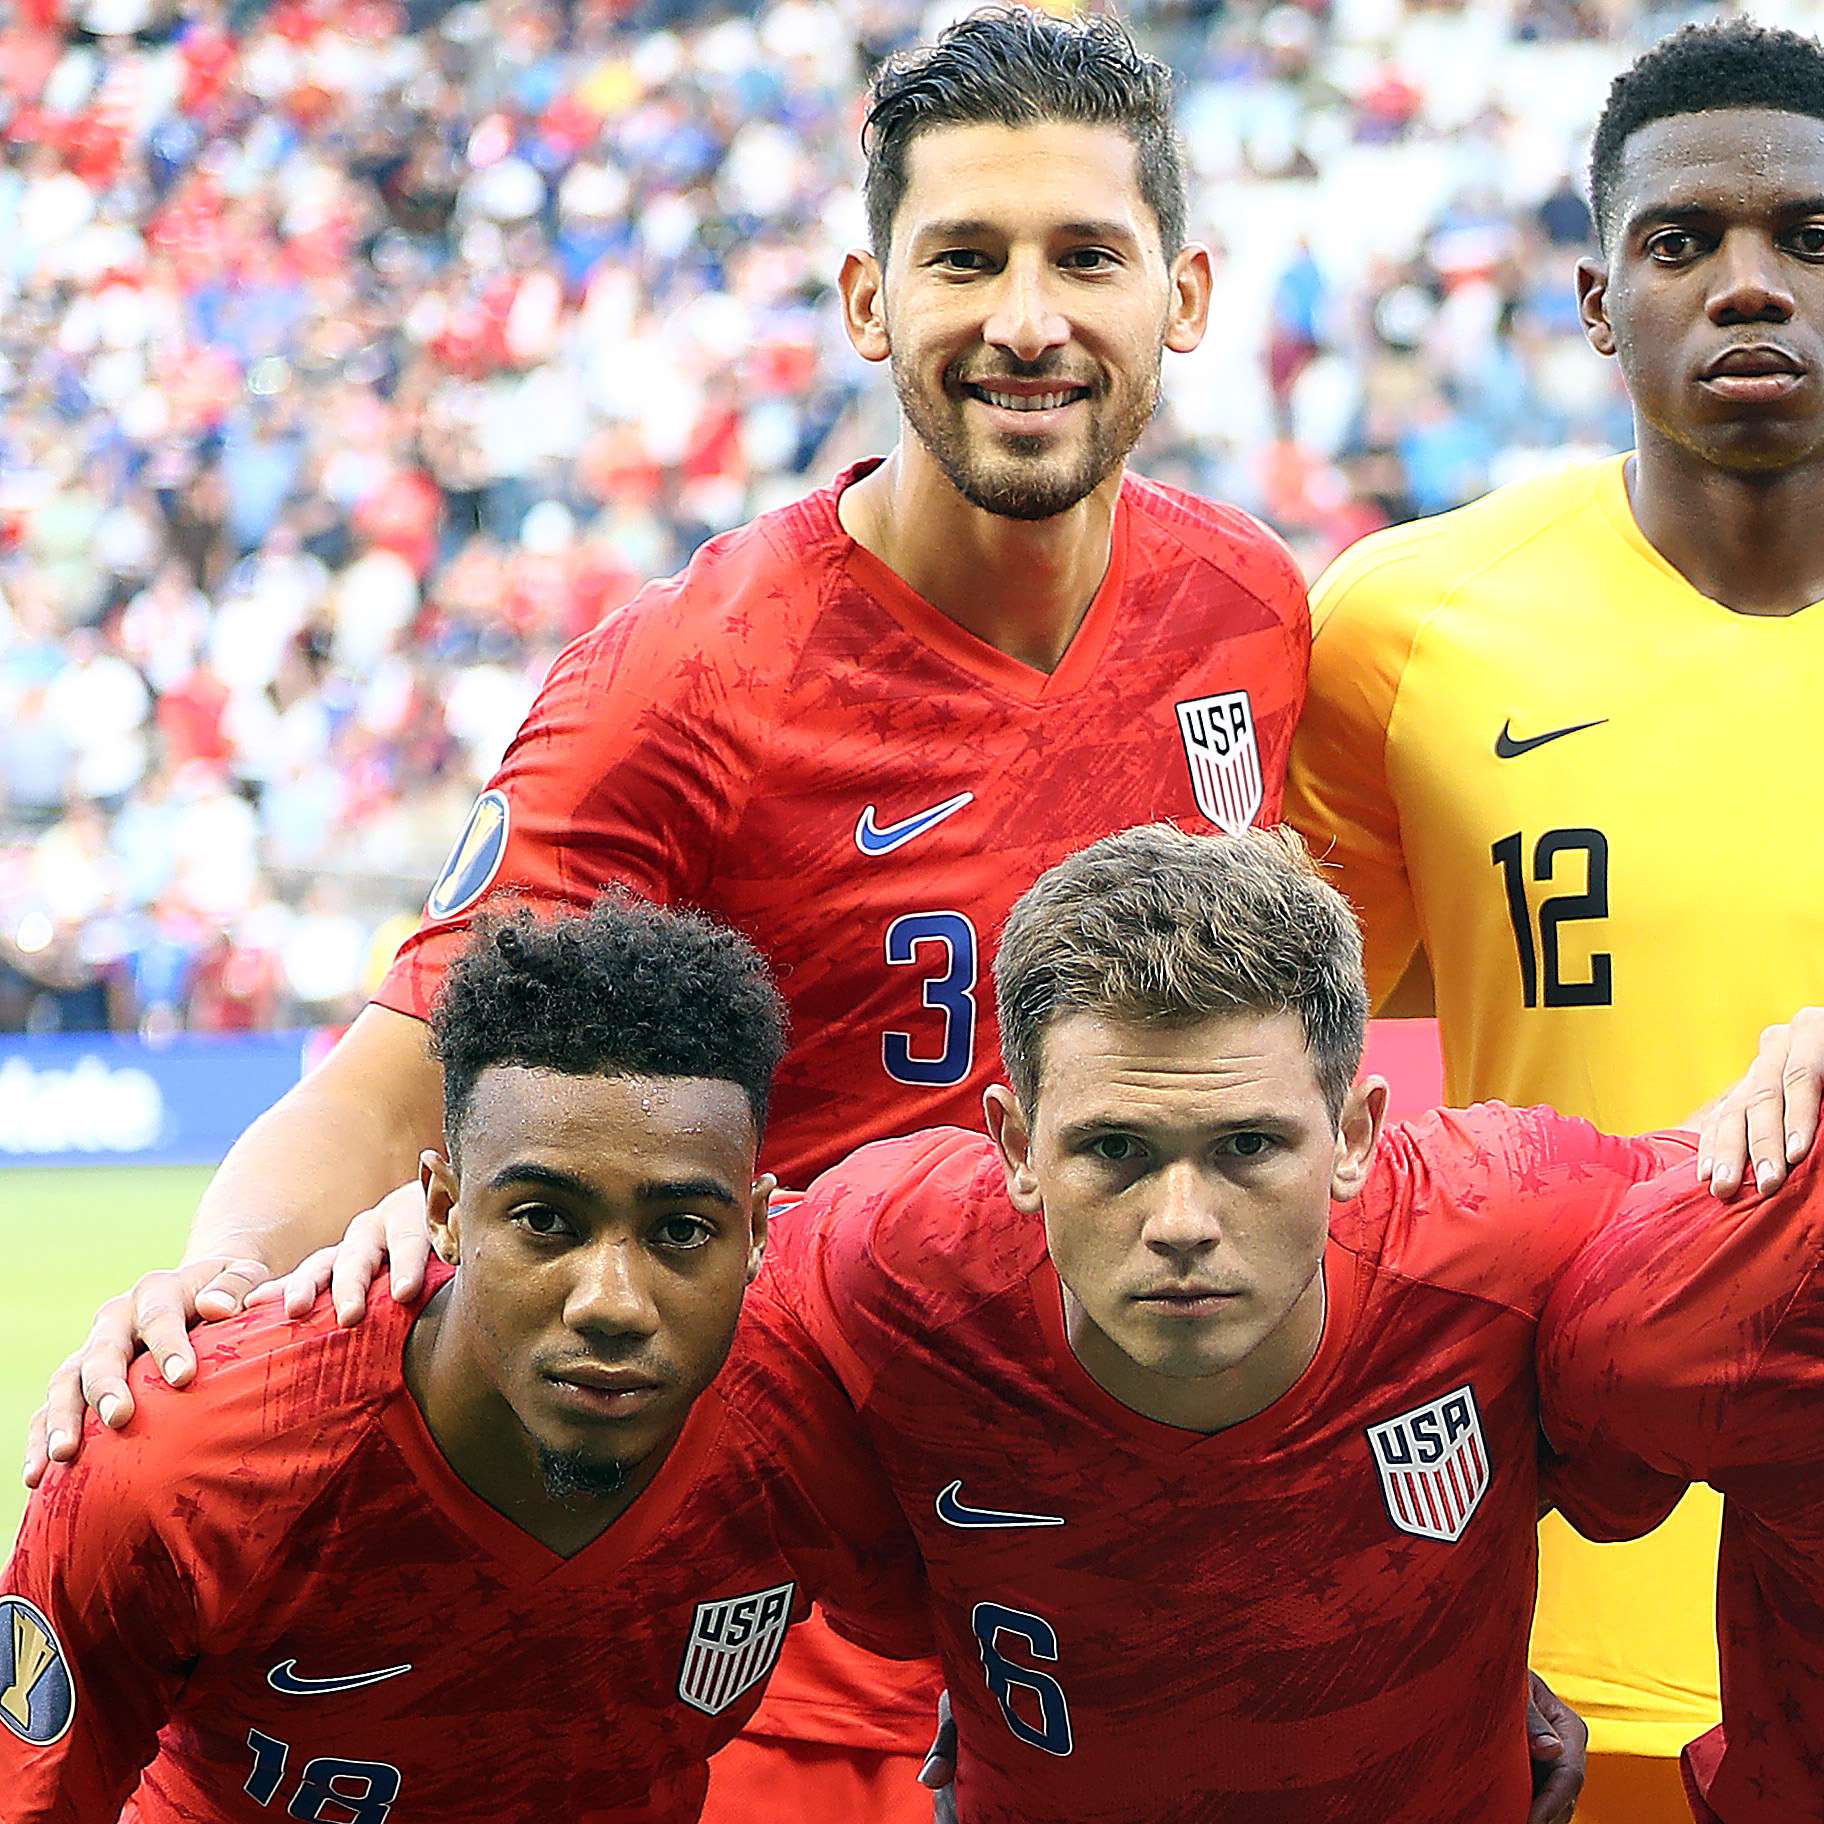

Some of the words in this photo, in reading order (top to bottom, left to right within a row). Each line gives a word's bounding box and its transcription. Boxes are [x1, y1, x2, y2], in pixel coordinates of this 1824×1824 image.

[1184, 702, 1248, 757] USA
[1491, 827, 1613, 1009] 12
[881, 908, 978, 1088] 3
[1376, 1393, 1470, 1465] USA
[697, 1588, 788, 1647] USA
[972, 1601, 1073, 1757] 6
